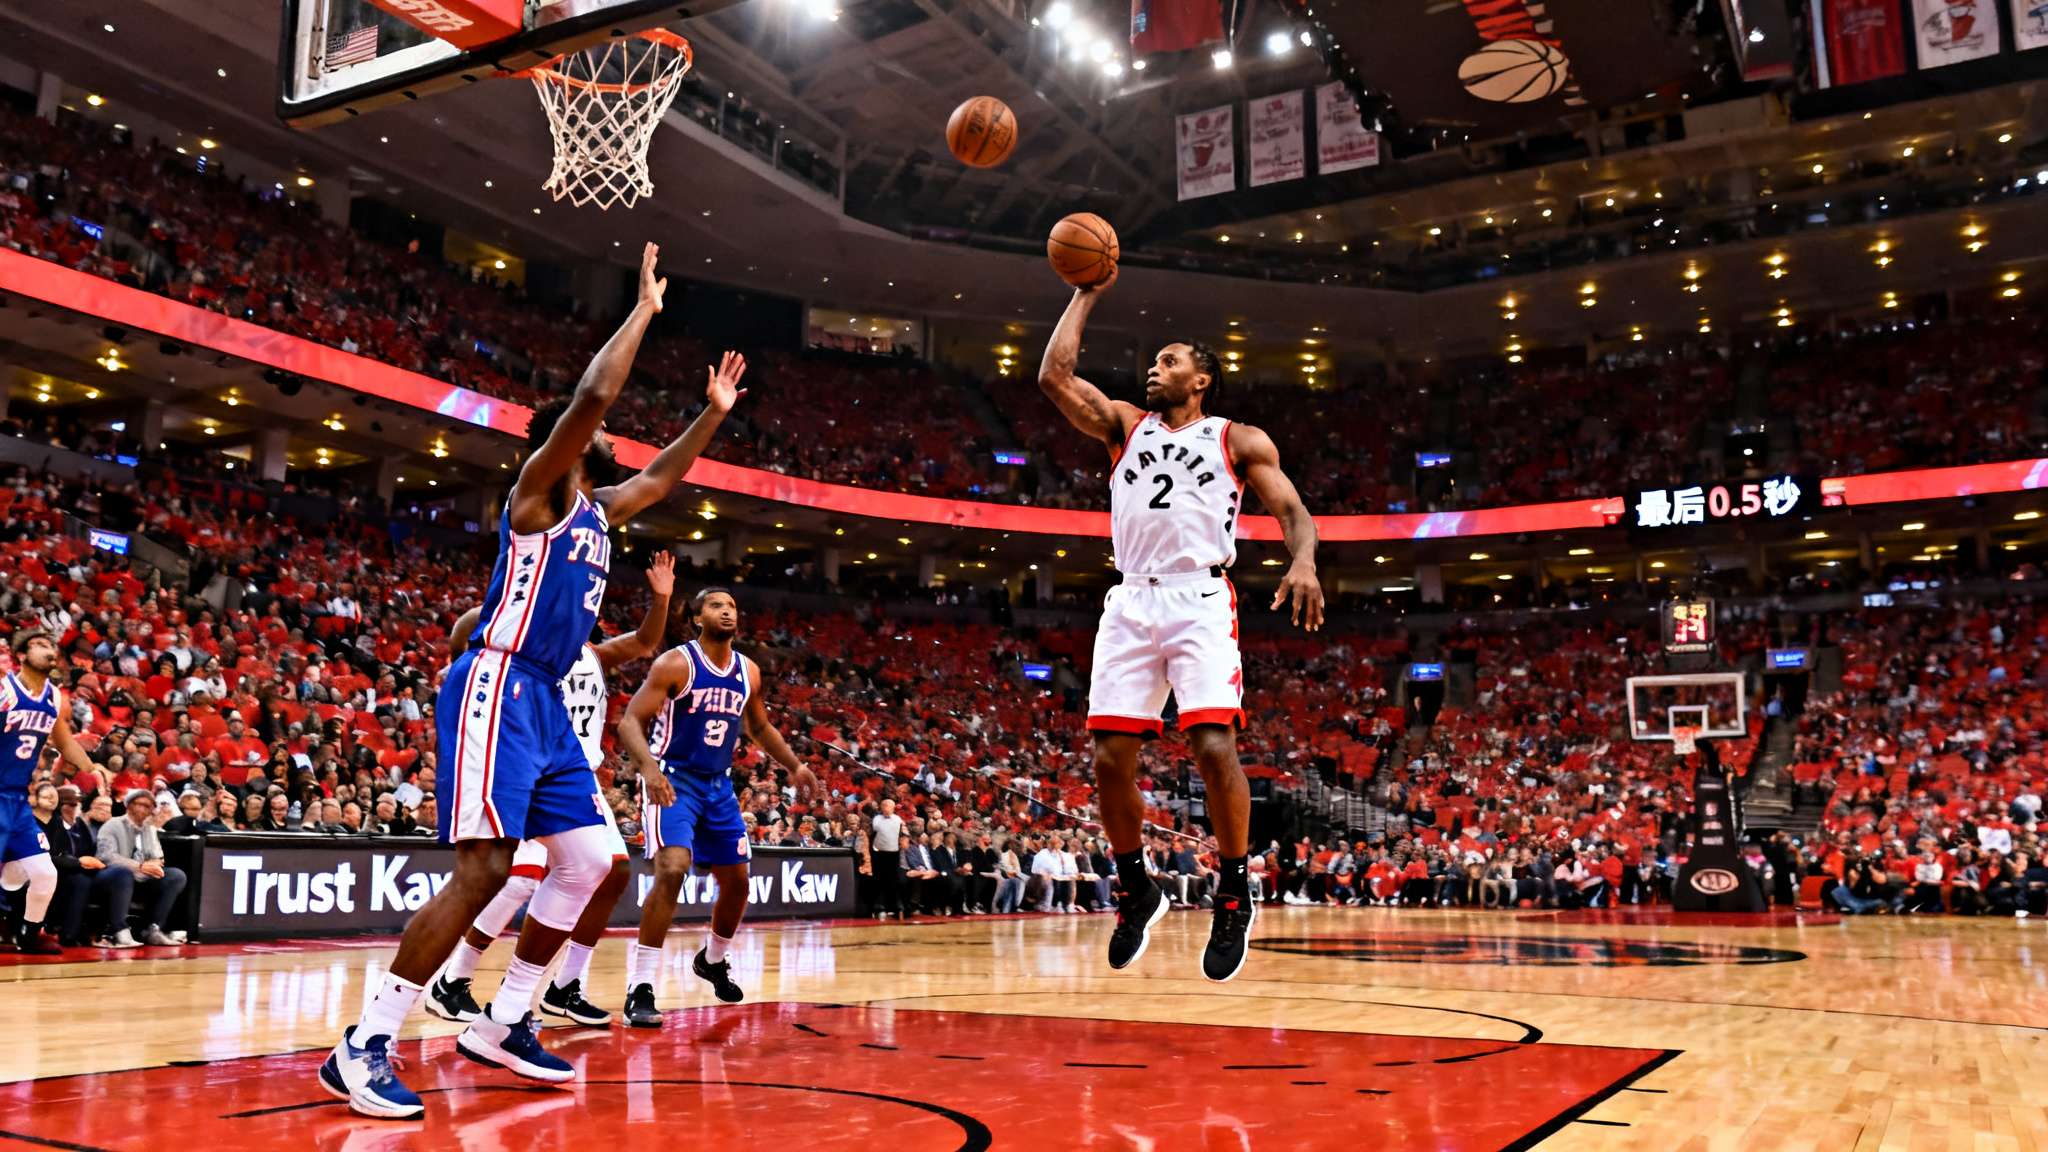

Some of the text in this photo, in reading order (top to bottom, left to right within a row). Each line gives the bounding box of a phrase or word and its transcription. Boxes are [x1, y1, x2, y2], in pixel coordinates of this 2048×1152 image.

[1149, 474, 1173, 509] 2
[1635, 476, 1800, 527] 最后0.5秒
[222, 855, 356, 914] Trust
[782, 861, 838, 904] Kaw
